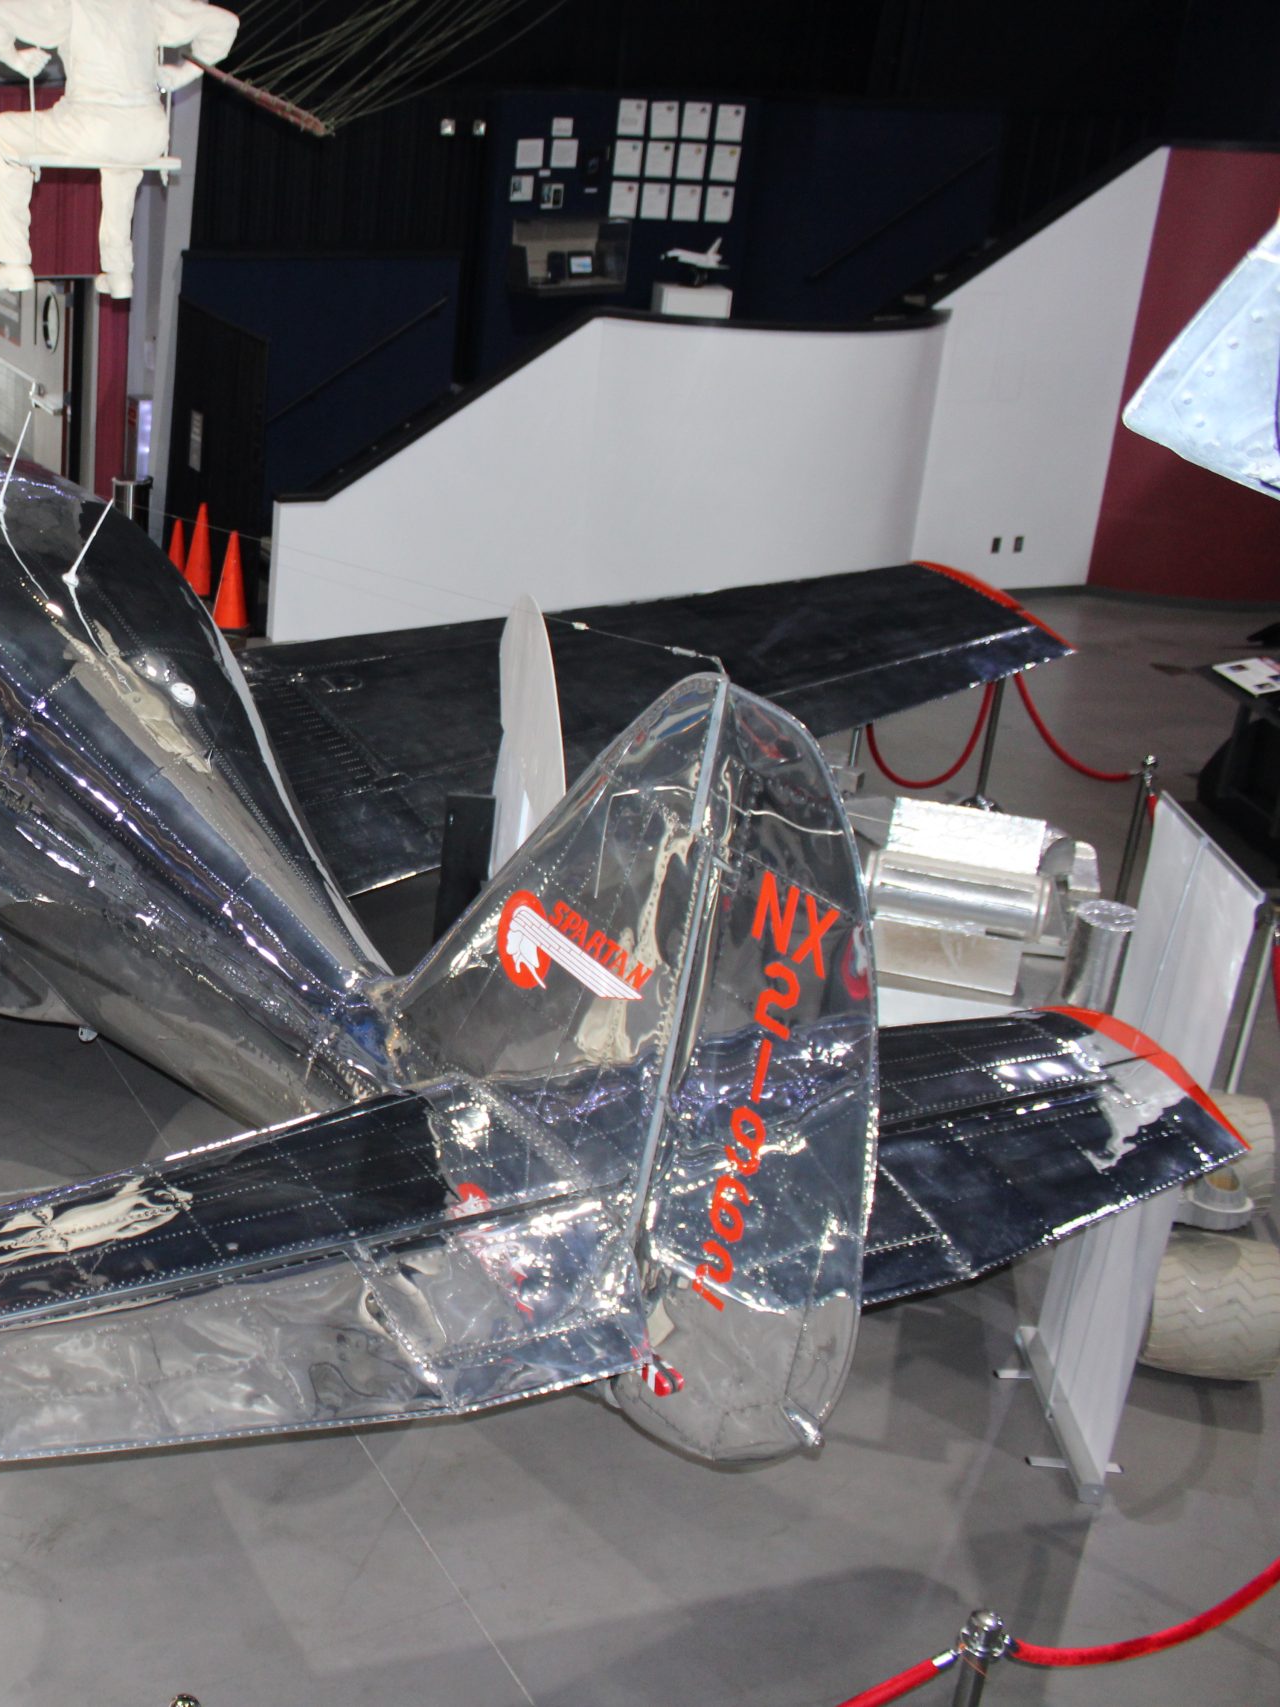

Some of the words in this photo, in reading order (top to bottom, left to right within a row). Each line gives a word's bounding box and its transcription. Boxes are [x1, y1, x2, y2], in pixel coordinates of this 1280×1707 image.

[548, 900, 653, 990] SPARTAN
[751, 870, 841, 980] NX
[692, 960, 802, 1312] 21962
